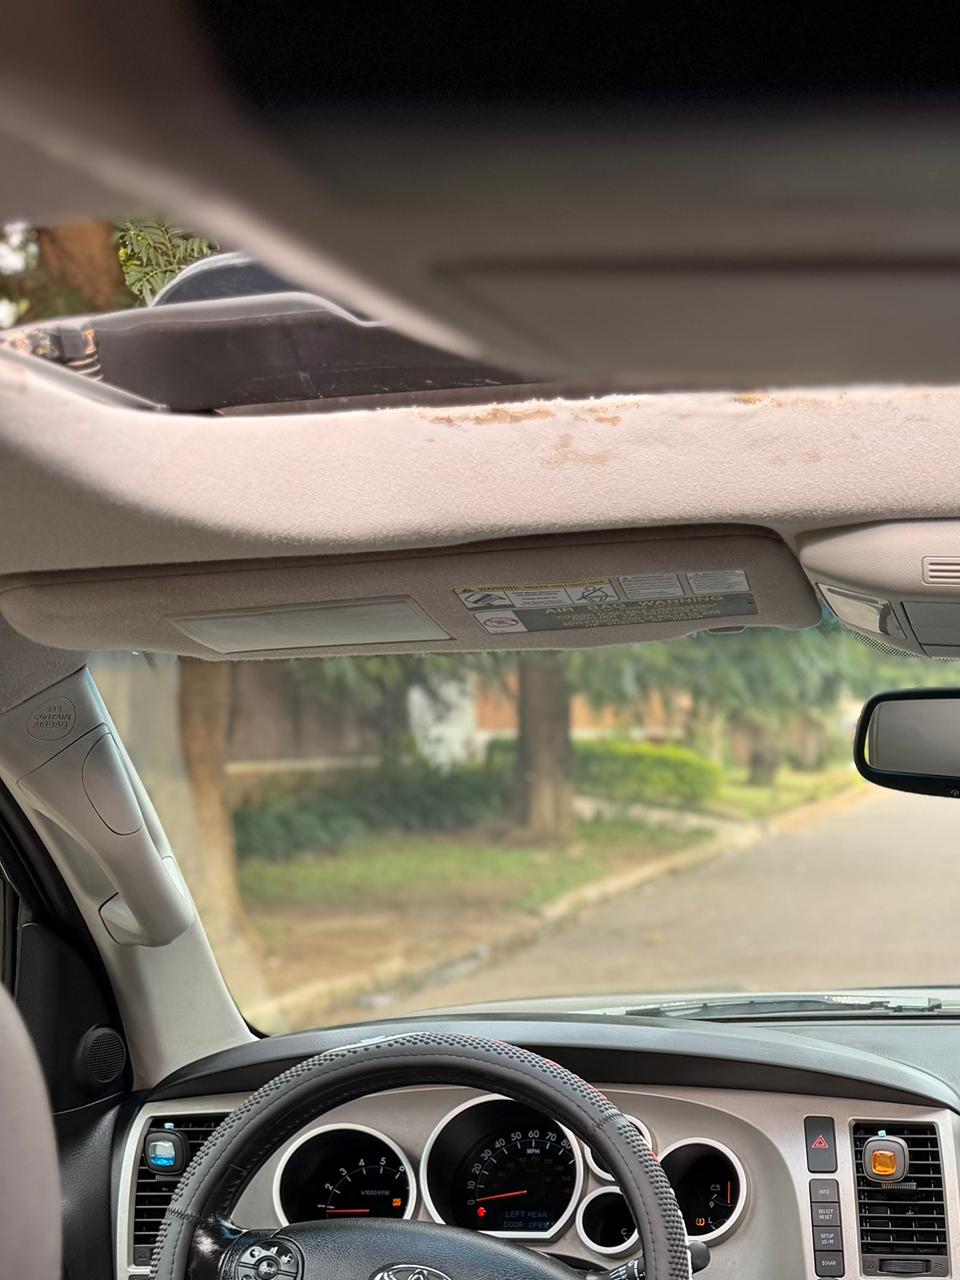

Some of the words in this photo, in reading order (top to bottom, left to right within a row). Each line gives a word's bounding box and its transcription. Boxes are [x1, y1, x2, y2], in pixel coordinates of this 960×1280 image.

[638, 595, 723, 607] WARNING
[510, 1131, 522, 1141] 50
[528, 1130, 540, 1138] 60
[545, 1131, 557, 1142] 70
[495, 1138, 506, 1149] 40
[480, 1149, 493, 1161] 30
[358, 1158, 365, 1166] 4
[379, 1157, 387, 1165] 5
[339, 1168, 347, 1176] 3
[471, 1163, 482, 1174] 20
[467, 1180, 476, 1190] 10
